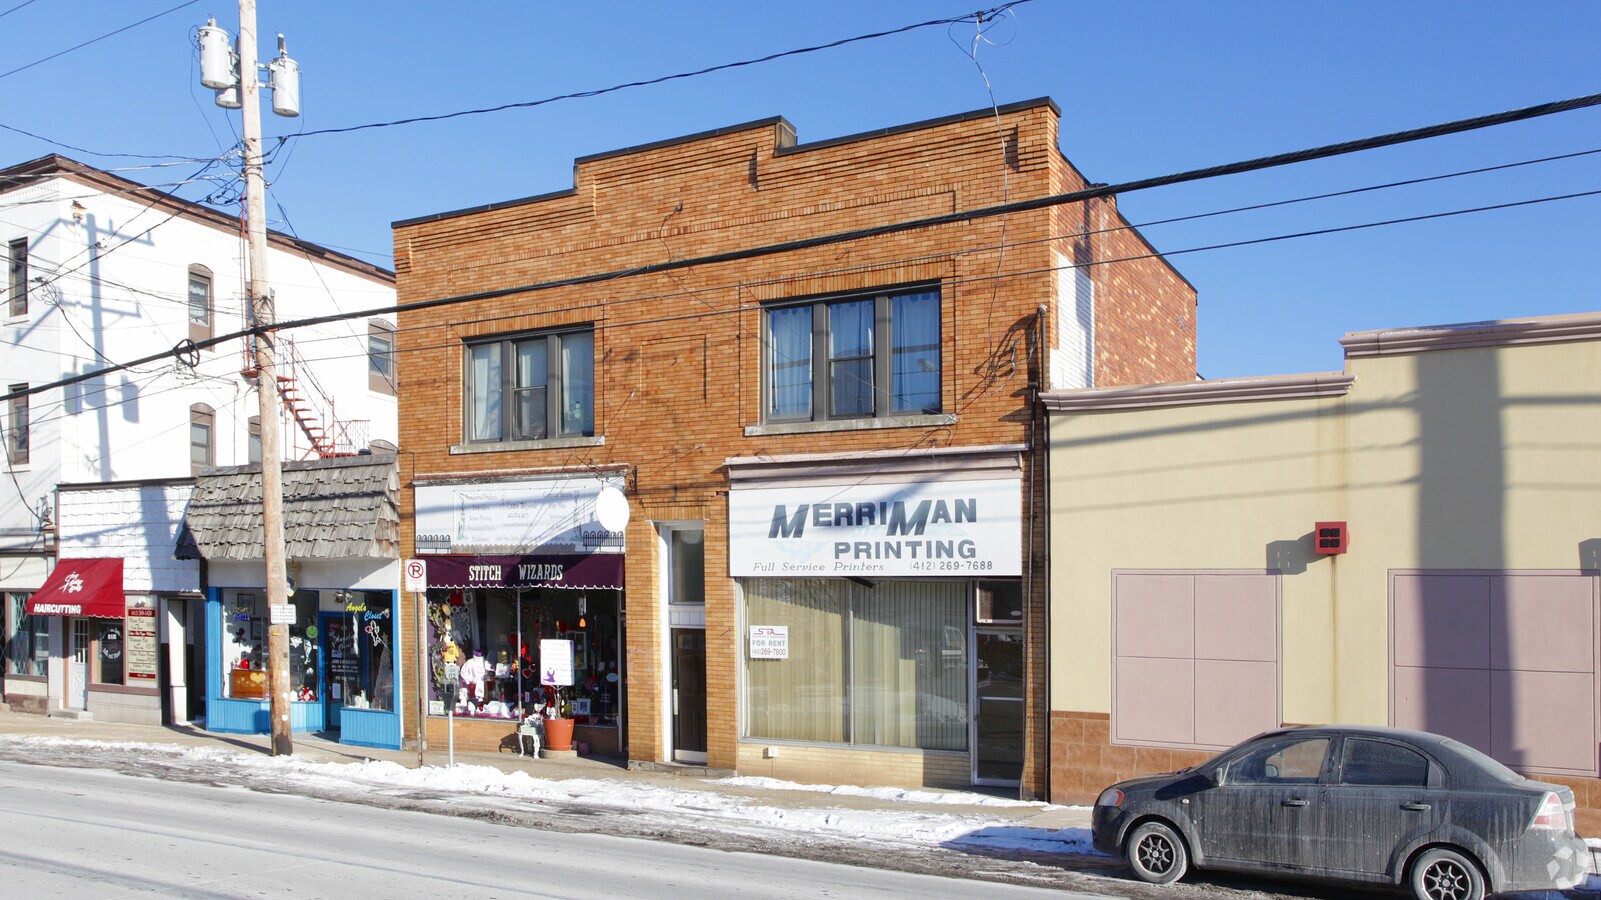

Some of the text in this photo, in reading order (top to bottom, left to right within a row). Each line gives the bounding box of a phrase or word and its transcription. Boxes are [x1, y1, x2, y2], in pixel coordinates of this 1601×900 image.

[834, 540, 977, 560] PRINTING
[753, 560, 993, 572] Full Service Printers (412) 269-7688
[468, 564, 563, 581] STITCH WIZARDS
[33, 603, 82, 614] HAIRCUTTING
[752, 639, 766, 647] FOR
